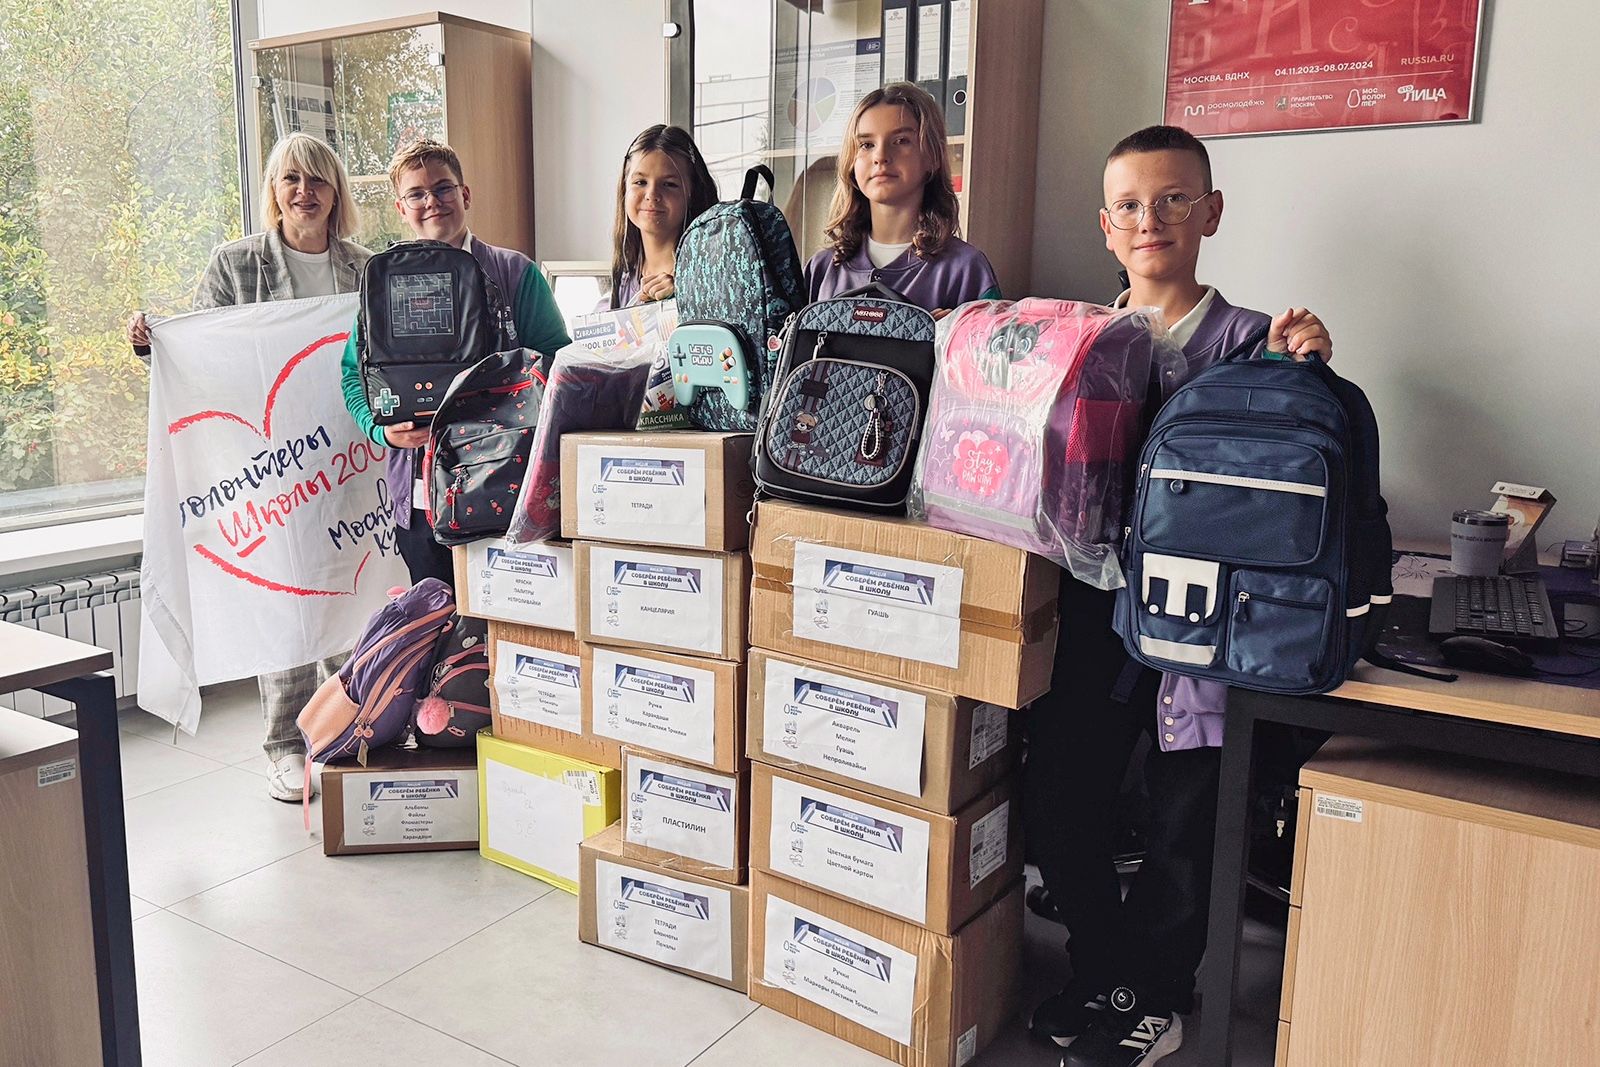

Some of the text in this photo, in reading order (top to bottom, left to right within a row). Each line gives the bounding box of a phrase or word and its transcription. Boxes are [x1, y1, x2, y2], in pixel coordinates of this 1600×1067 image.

[1400, 54, 1455, 66] RUSSIA.RU
[1225, 72, 1250, 81] ВДНХ
[1274, 61, 1373, 77] 04.11.2023-08.07.2024
[1403, 88, 1447, 102] ЛИЦА
[603, 338, 617, 347] BOX
[963, 449, 994, 475] Stay
[217, 470, 332, 547] Школы
[845, 575, 910, 592] СОБЕРЁМ РЕБЁНКА
[865, 586, 891, 597] ШКОЛУ
[640, 606, 675, 615] КАНЦЕЛЯРИЯ
[867, 608, 889, 618] ГУАШЬ
[814, 694, 876, 715] СОБЕРЁМ РЕБЁНКА
[835, 706, 860, 717] ШКОЛУ
[831, 720, 861, 733] Акварель
[835, 733, 856, 744] Мелки
[823, 753, 867, 771] Непроливайки
[657, 783, 684, 794] СОБЕРЁМ
[685, 789, 711, 800] РЕБЁНКА
[675, 794, 697, 803] ШКОЛУ
[662, 816, 706, 833] ПЛАСТИЛИН
[820, 813, 850, 828] СОБЕРЁМ
[851, 823, 881, 837] РЕБЁНКА
[840, 826, 864, 839] ШКОЛУ
[827, 847, 874, 868] Цветная бумага
[826, 858, 874, 880] Цветной картон
[638, 890, 664, 902] СОБЕРЁМ
[665, 897, 690, 908] РЕБЁНКА
[656, 900, 676, 911] ШКОЛУ
[654, 918, 677, 930] ТЕТРАДИ
[812, 935, 841, 953] СОБЕРЁМ
[842, 949, 871, 966] РЕБЁНКА
[830, 950, 854, 966] ШКОЛУ
